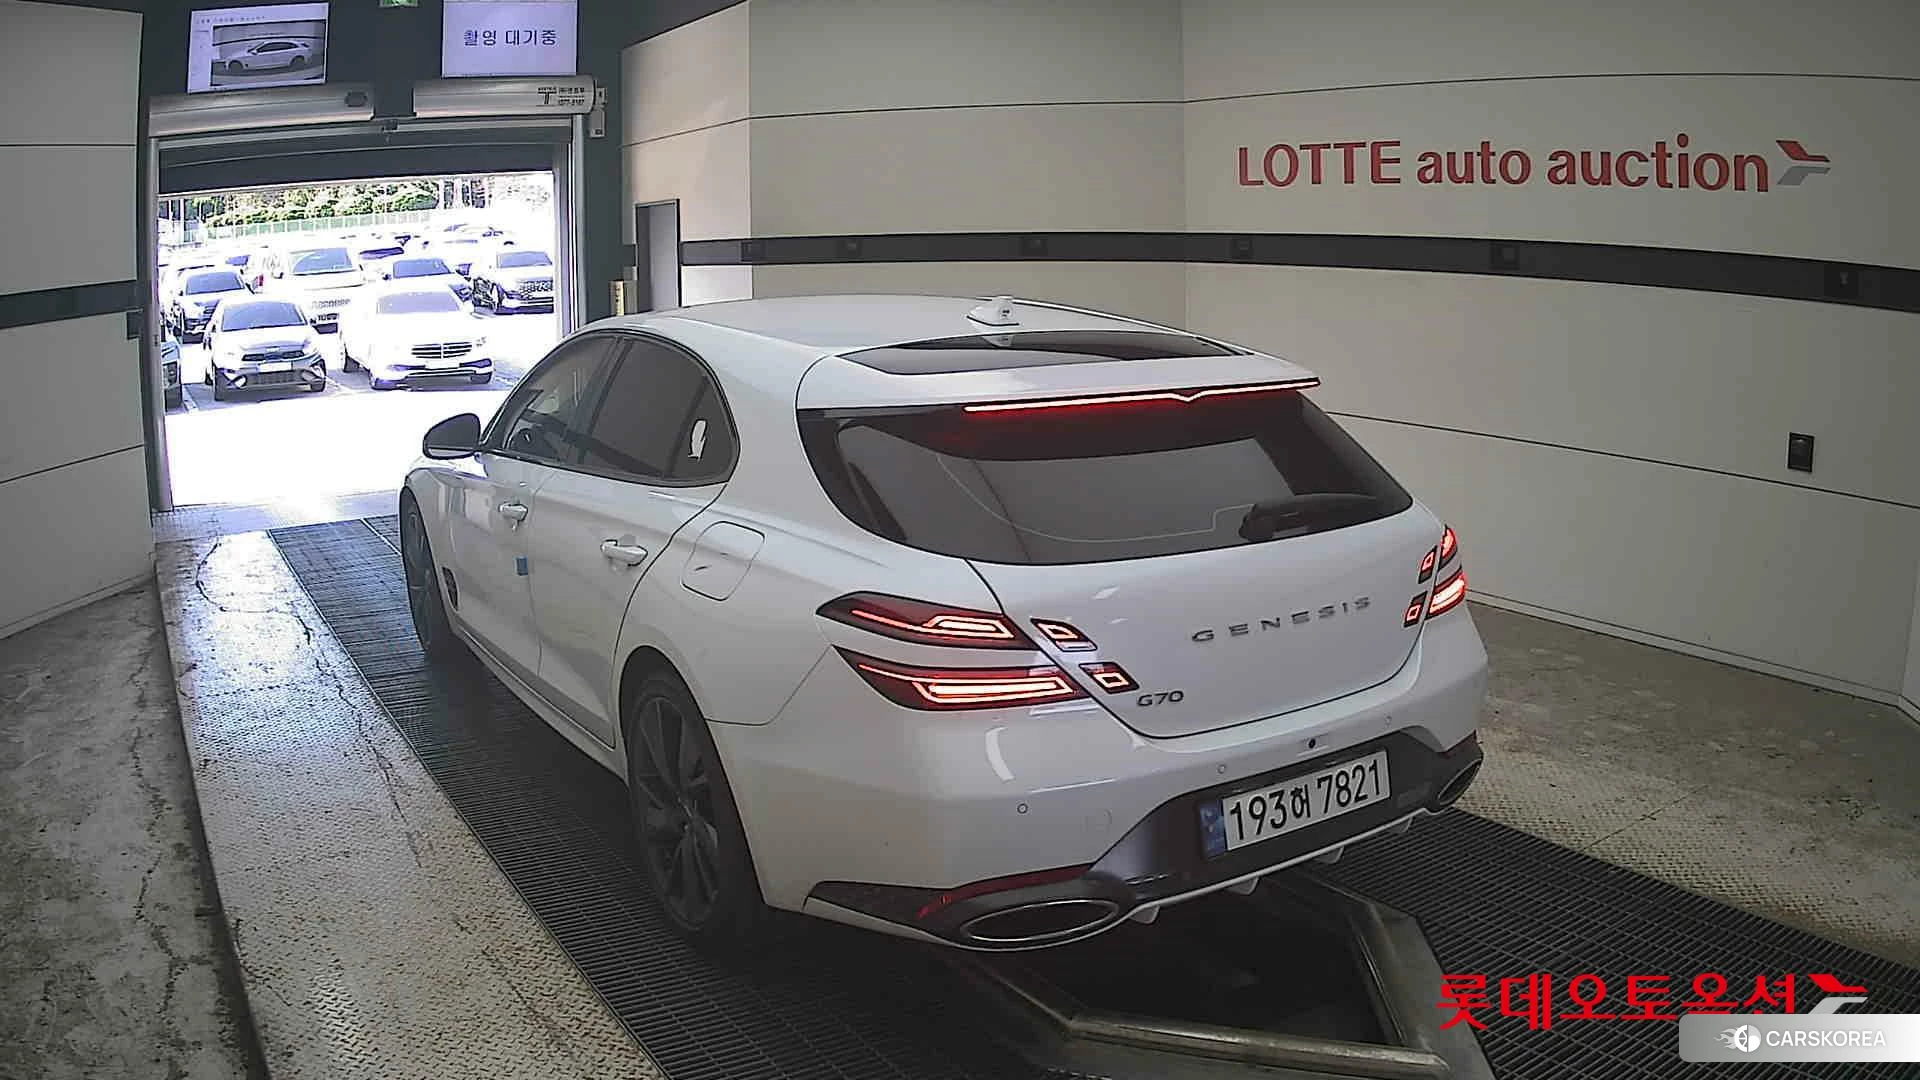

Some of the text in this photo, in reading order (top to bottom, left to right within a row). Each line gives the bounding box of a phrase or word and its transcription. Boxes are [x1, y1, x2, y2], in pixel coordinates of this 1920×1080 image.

[505, 30, 556, 46] 대기중
[1239, 133, 1768, 192] LOTTE auto auction
[1192, 597, 1370, 642] GENESIS
[1137, 690, 1184, 706] G70
